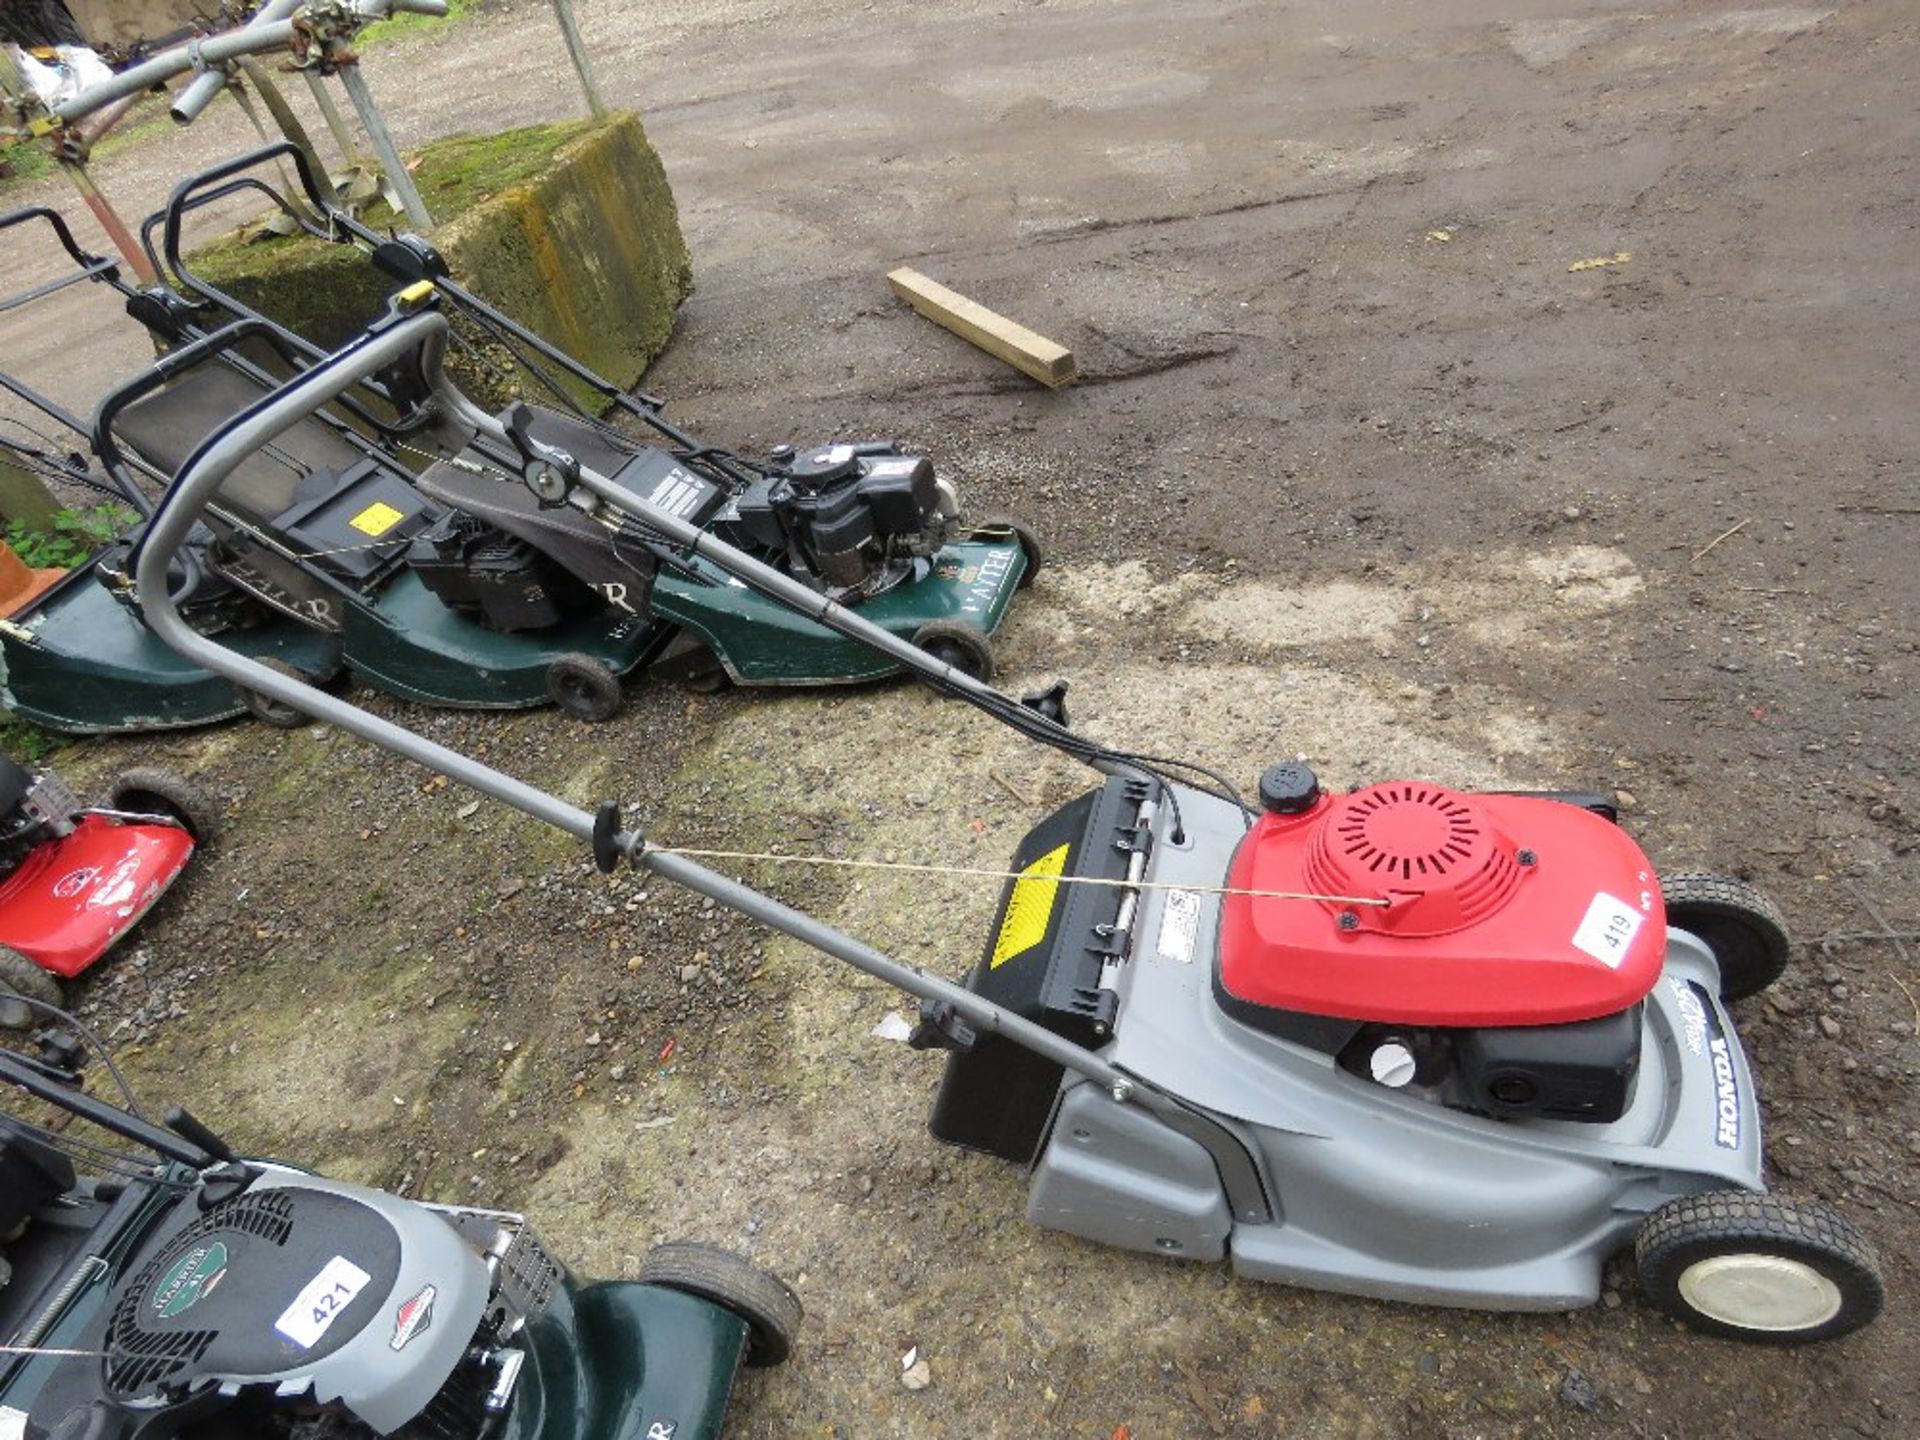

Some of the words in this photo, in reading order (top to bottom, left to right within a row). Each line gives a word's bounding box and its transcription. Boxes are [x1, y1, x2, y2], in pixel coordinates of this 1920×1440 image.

[1603, 914, 1632, 949] 419
[1710, 1037, 1738, 1151] HONDA
[312, 1281, 351, 1325] 421
